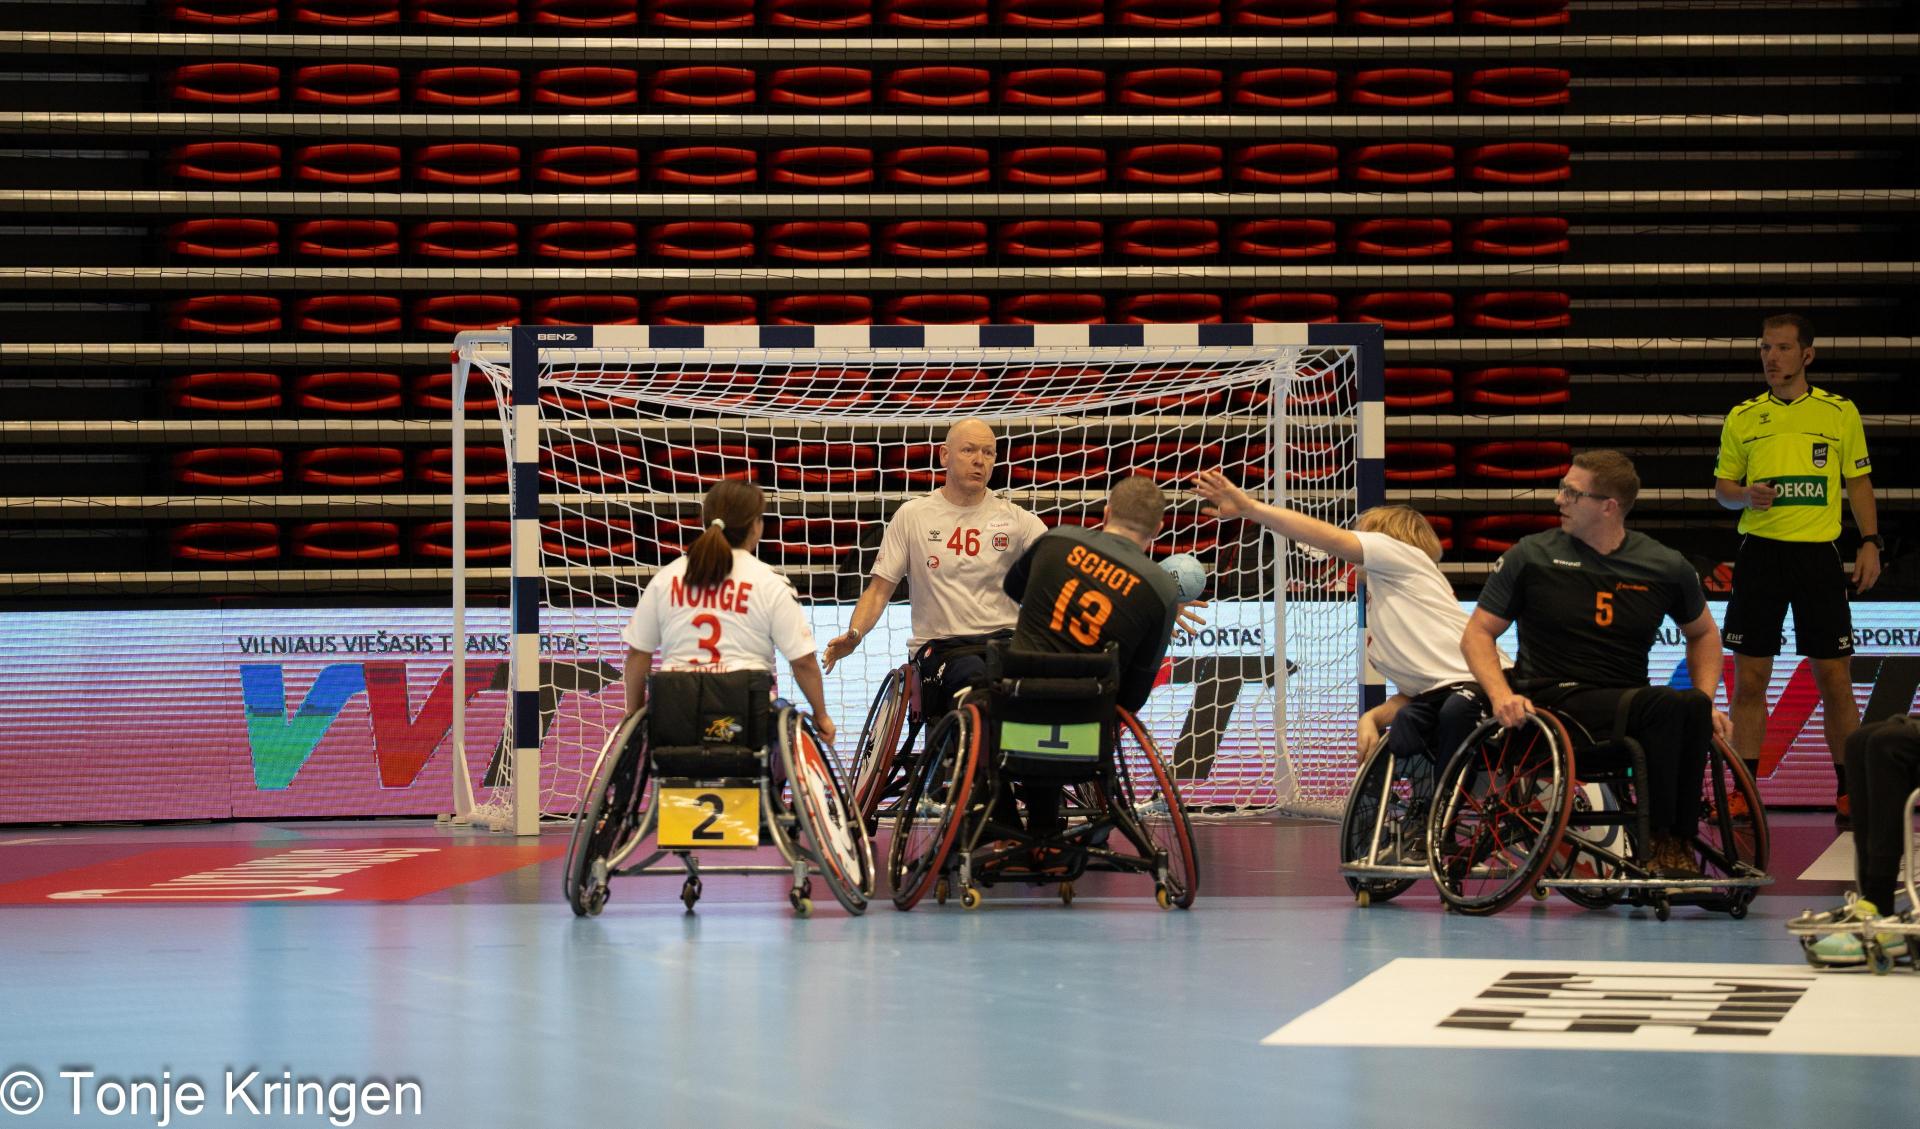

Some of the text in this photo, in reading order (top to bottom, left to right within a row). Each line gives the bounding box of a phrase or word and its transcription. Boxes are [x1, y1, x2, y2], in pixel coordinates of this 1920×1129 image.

[537, 333, 575, 341] BENZ
[947, 526, 981, 557] 46
[1066, 545, 1139, 596] SCHOT
[1049, 578, 1113, 646] 13
[1595, 591, 1613, 627] 5
[239, 631, 590, 655] VILNIAUS VIEŠASIS TANSRTAS
[690, 613, 722, 664] 3
[1726, 632, 1744, 642] EHF
[692, 793, 724, 840] 2
[1436, 971, 1815, 1036] SELECT
